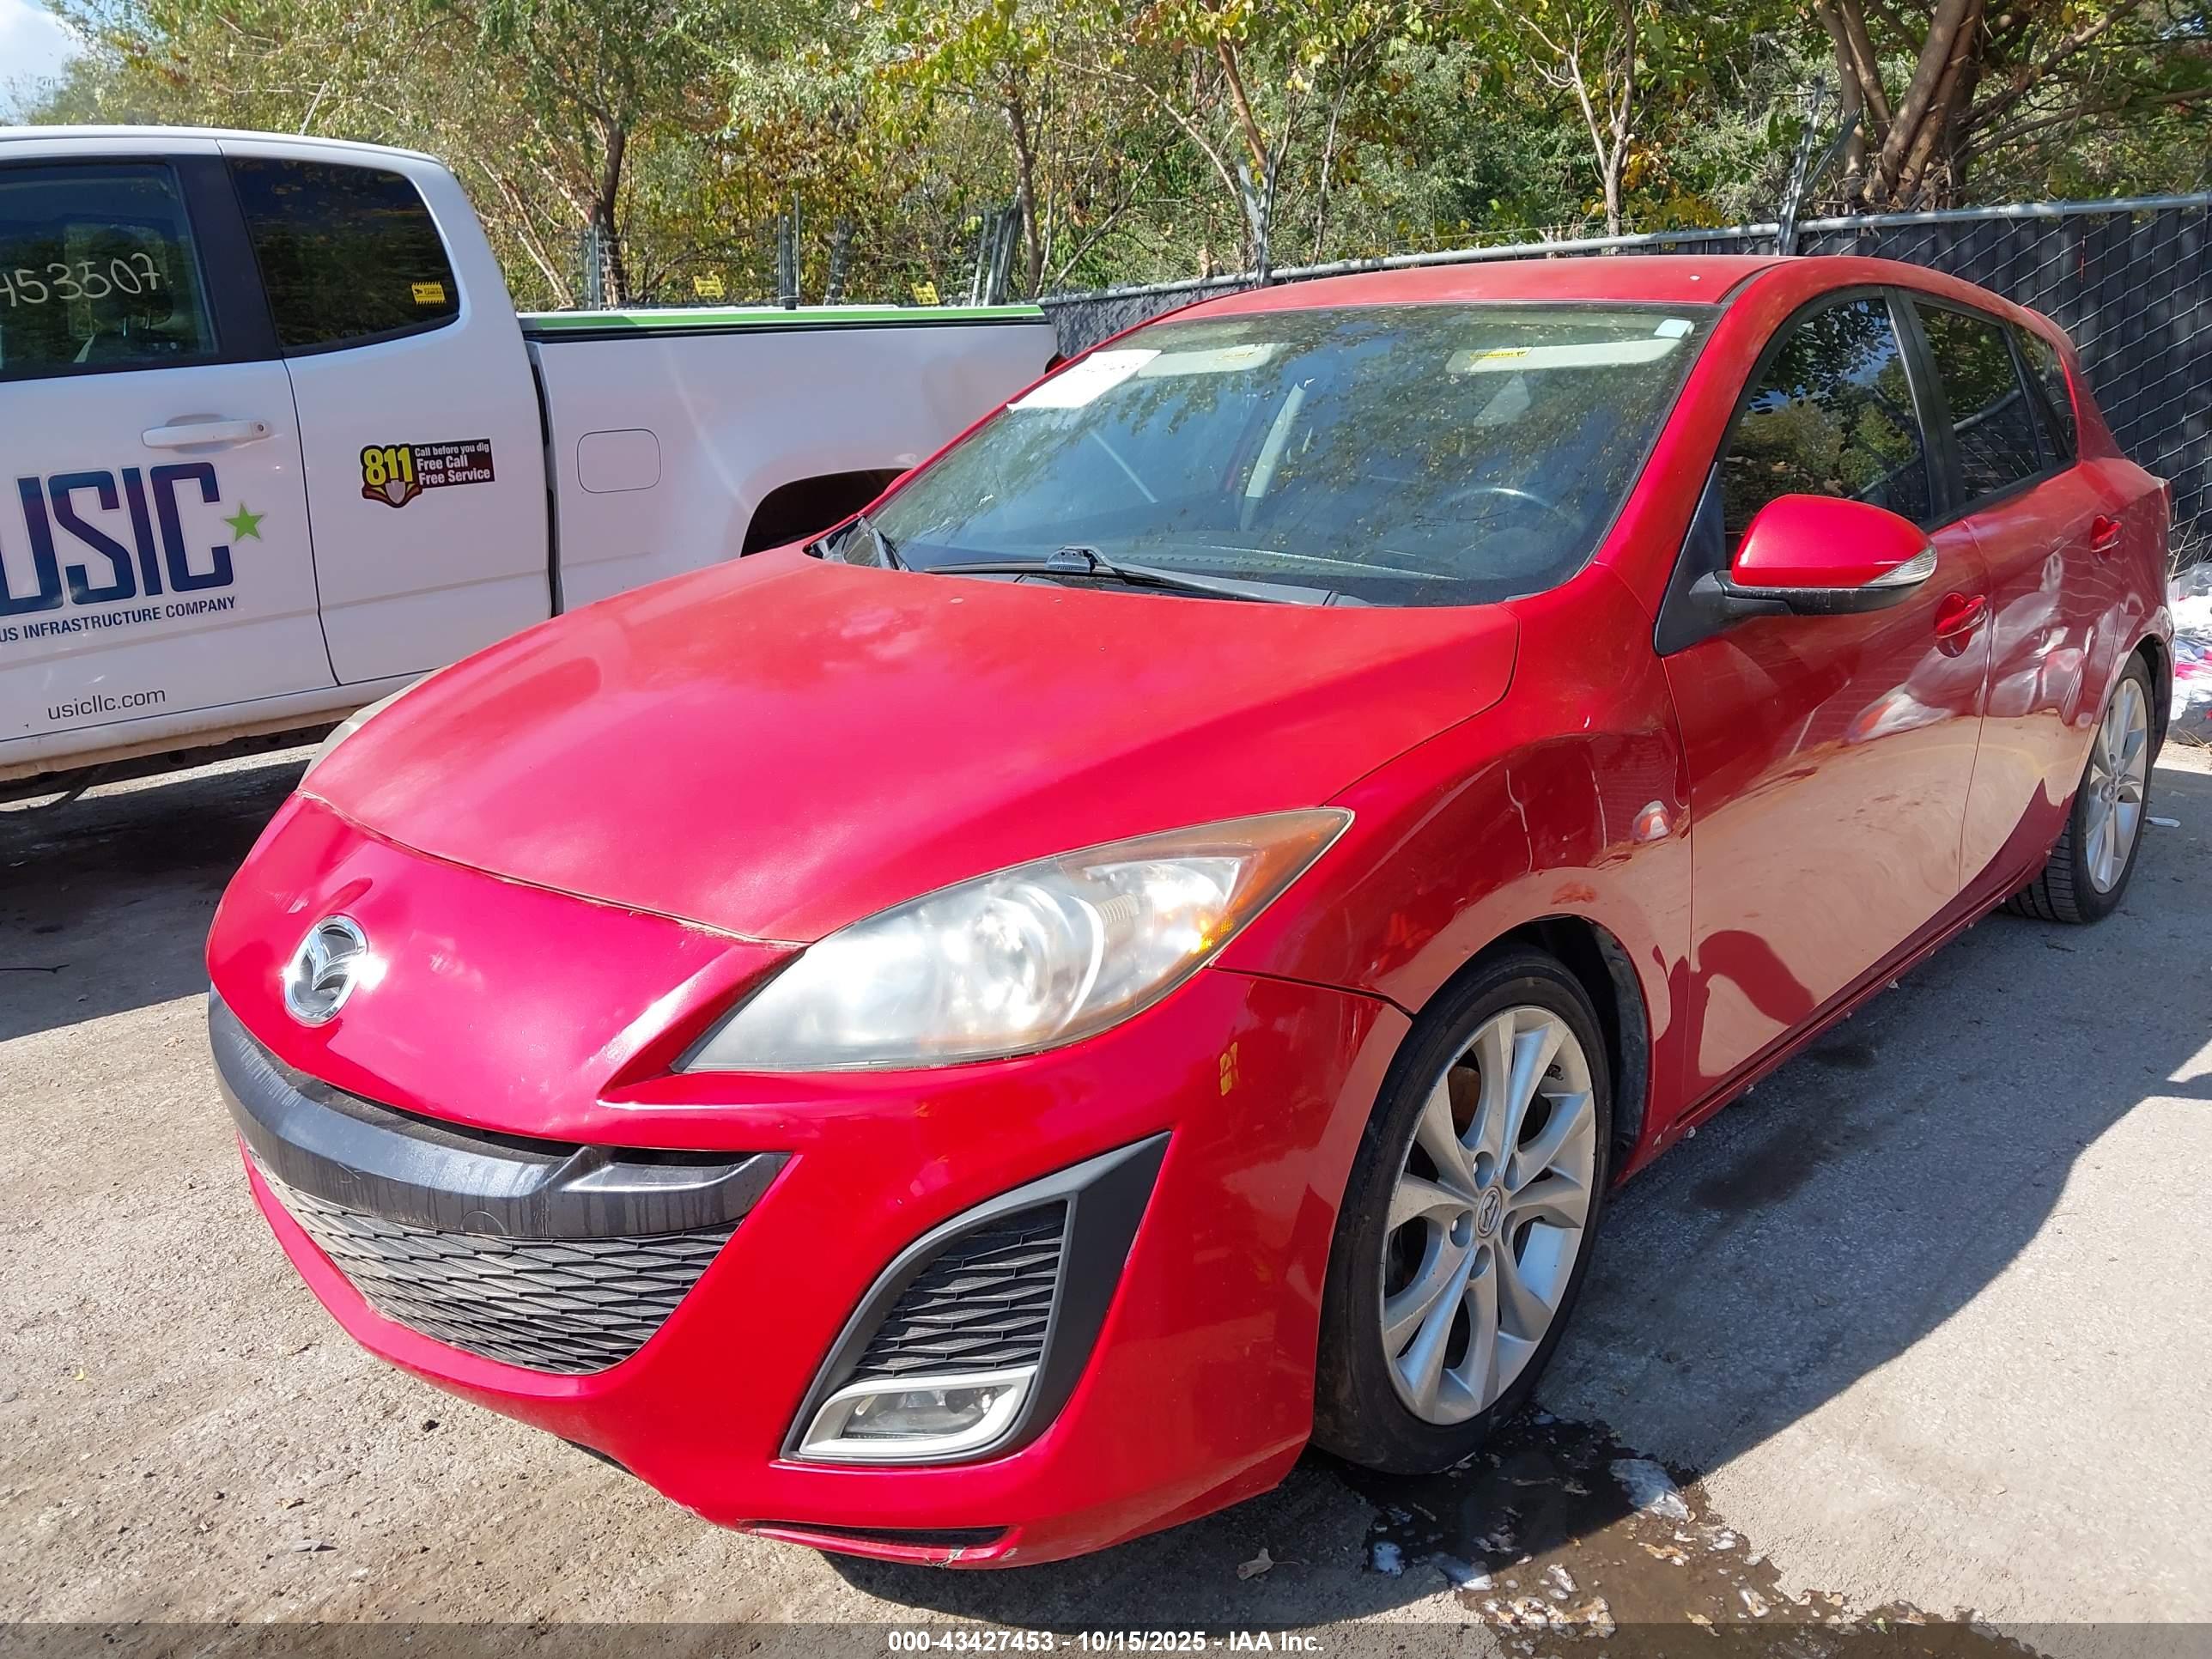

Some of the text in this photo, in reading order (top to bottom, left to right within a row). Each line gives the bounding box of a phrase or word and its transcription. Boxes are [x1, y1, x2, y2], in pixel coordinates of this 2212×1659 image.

[415, 442, 489, 458] Call before you dig
[416, 454, 468, 471] Free Call
[363, 447, 413, 486] 811
[418, 467, 490, 486] Free Service
[0, 461, 234, 617] USIC
[23, 606, 162, 639] INFRASTRUCTURE
[165, 596, 236, 618] COMPANY
[47, 690, 166, 720] usicllc.com
